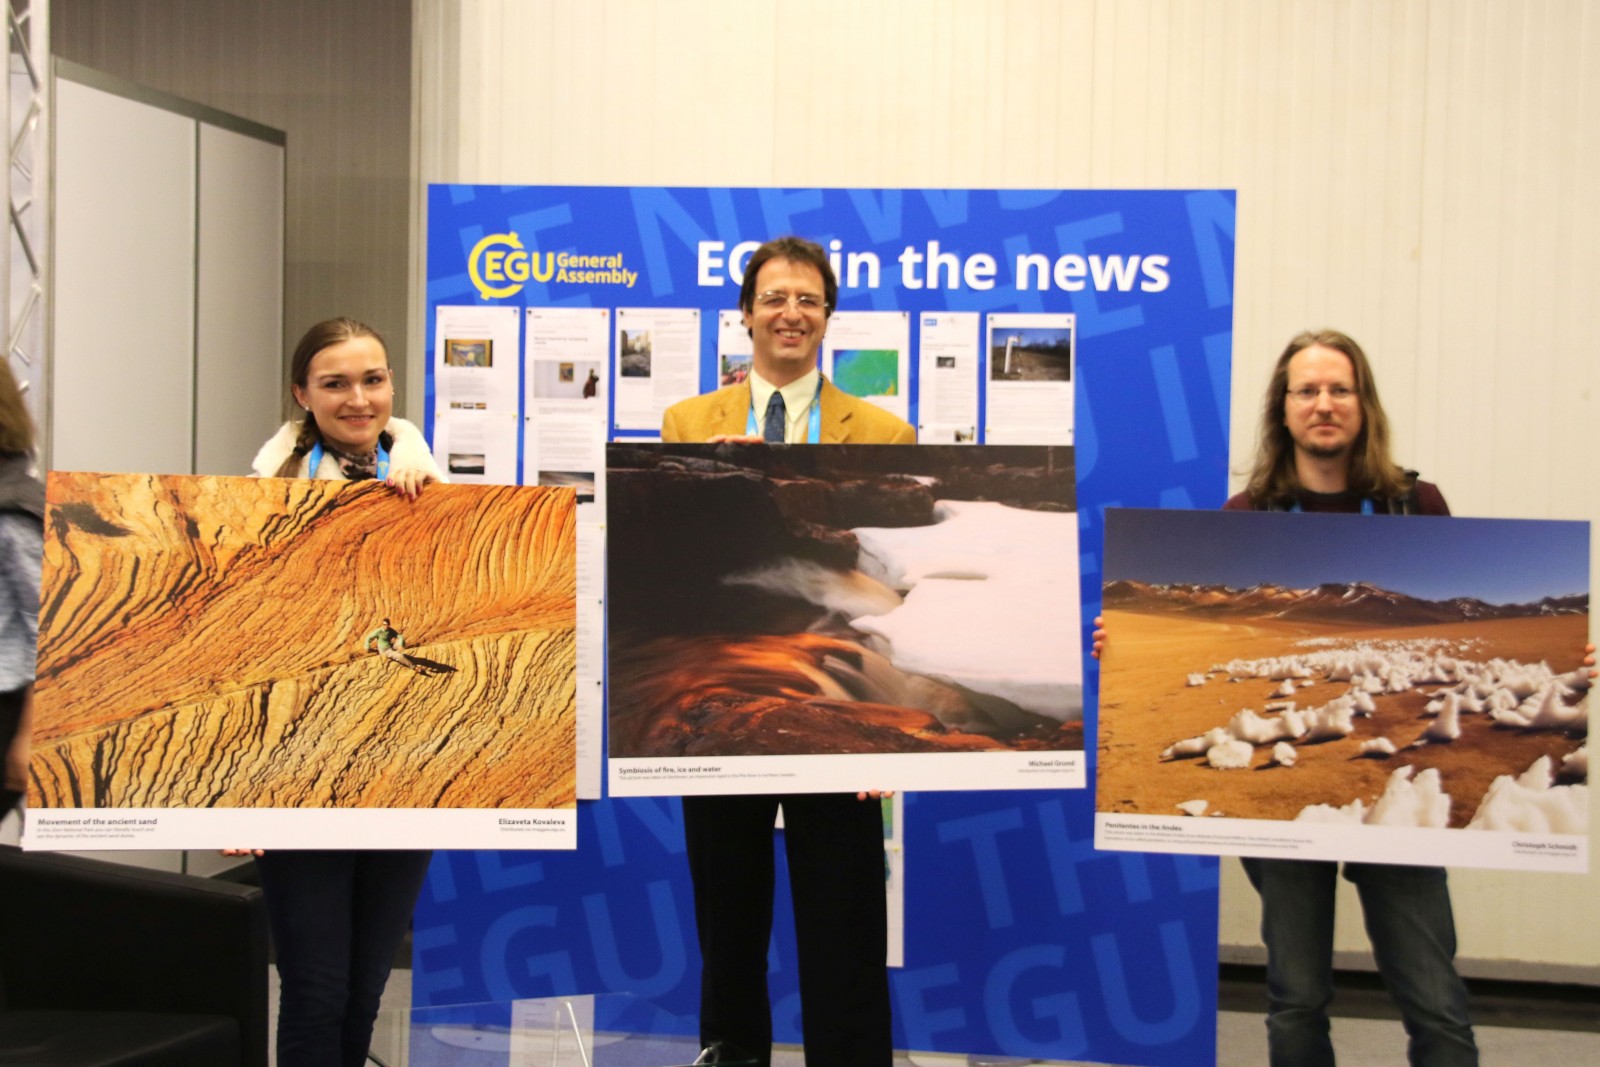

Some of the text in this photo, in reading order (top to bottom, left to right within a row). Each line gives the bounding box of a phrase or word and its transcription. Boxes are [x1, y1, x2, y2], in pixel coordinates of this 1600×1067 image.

[484, 251, 555, 283] EGU
[557, 252, 623, 269] General
[829, 239, 881, 289] in
[898, 241, 998, 290] the
[1015, 253, 1171, 293] news
[556, 268, 638, 288] Assembly
[619, 767, 653, 775] Symbiosis
[662, 766, 676, 774] fire,
[38, 817, 158, 826] Movement of the ancient sand
[1105, 822, 1140, 830] Penitentes
[1161, 824, 1183, 832] Andes
[1548, 843, 1577, 851] Schmidt
